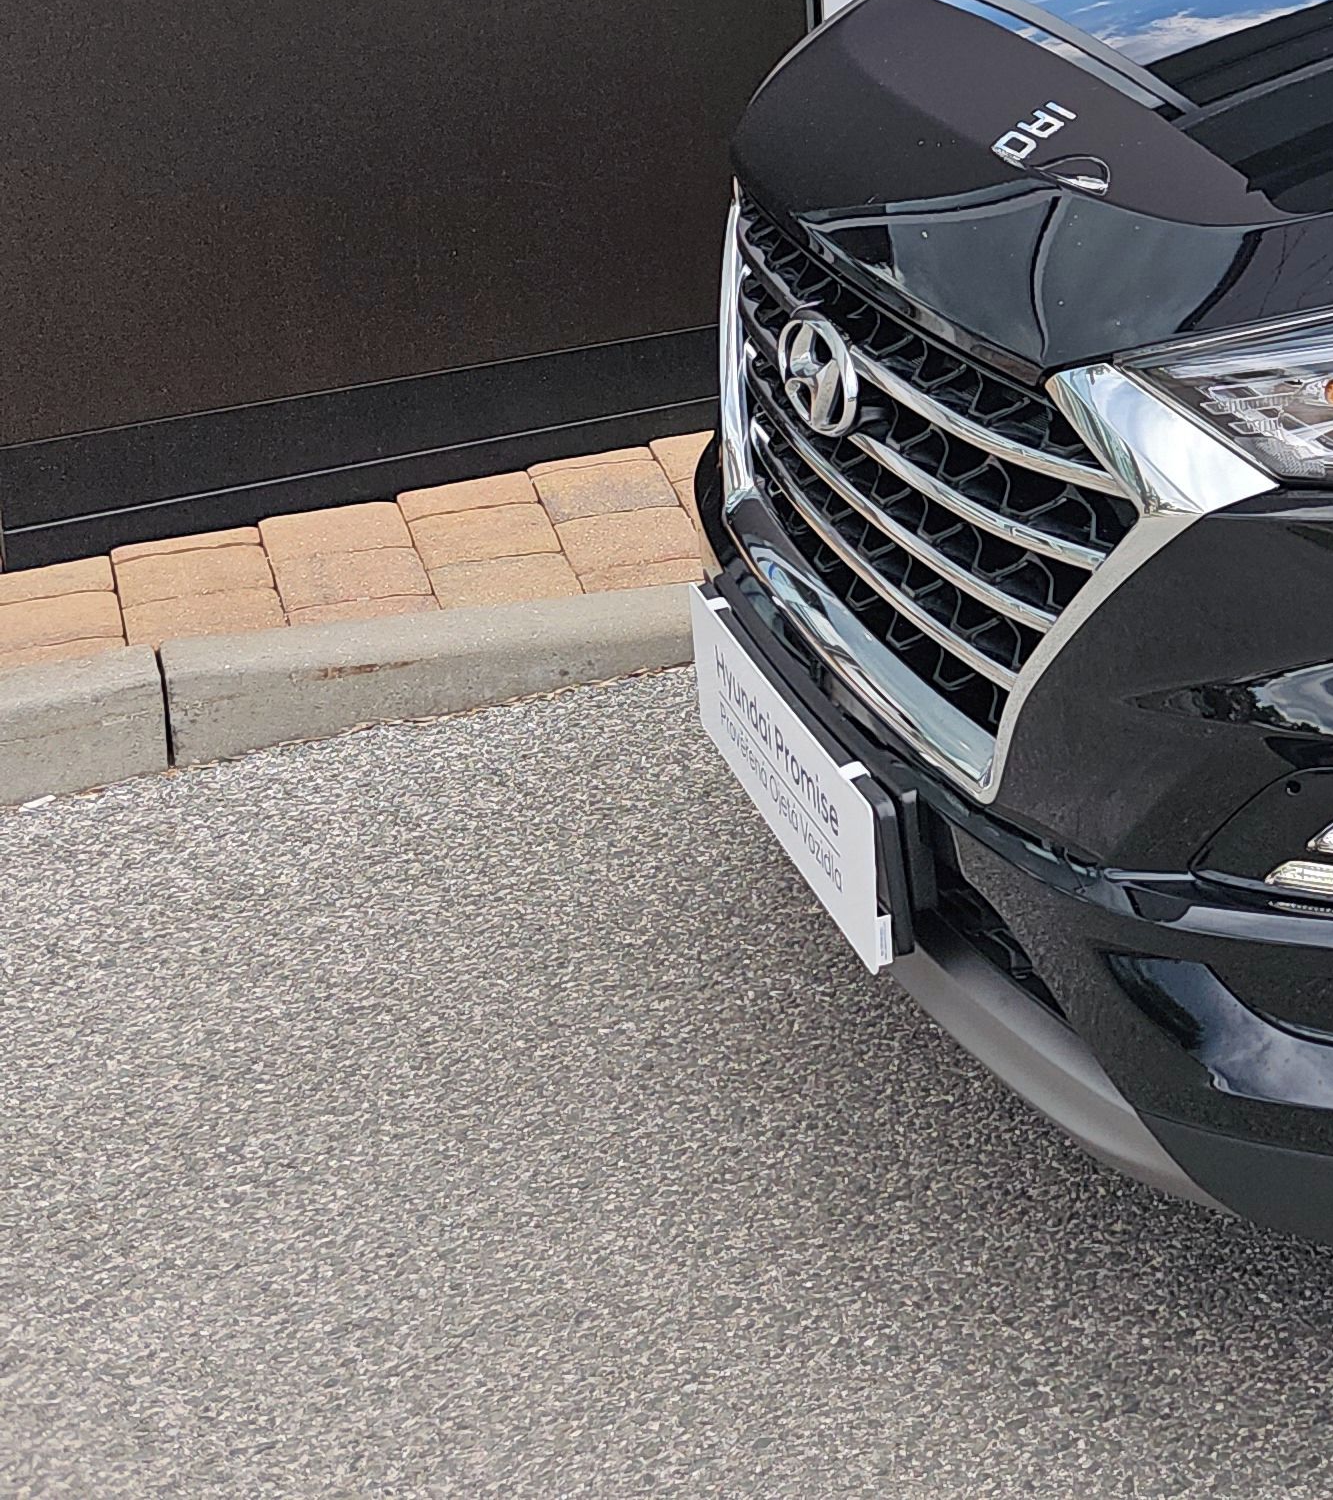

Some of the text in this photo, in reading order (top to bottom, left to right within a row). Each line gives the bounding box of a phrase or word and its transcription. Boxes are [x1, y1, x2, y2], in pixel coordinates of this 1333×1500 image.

[714, 644, 840, 837] Hyundai Promise
[719, 700, 844, 894] Prověřená Ojetá Vozidla
